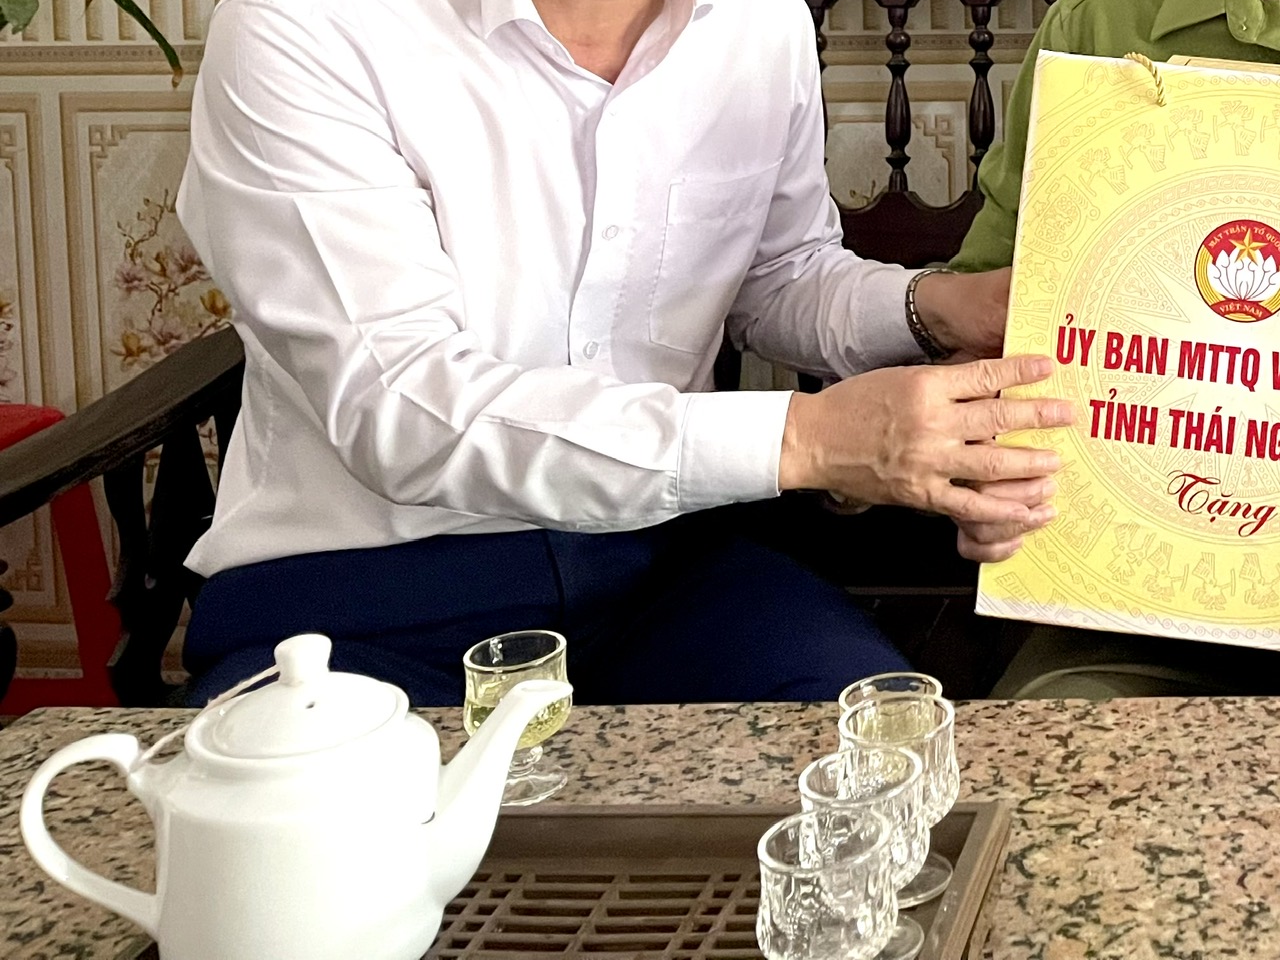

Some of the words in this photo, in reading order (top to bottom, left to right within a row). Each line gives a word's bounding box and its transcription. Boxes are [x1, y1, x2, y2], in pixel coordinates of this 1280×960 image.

[1242, 304, 1263, 317] NAM
[1057, 314, 1096, 367] ỦY
[1104, 332, 1169, 376] BAN
[1178, 341, 1261, 392] MTTQ
[1089, 387, 1159, 445] TỈNH
[1169, 406, 1237, 455] THÁI
[1167, 469, 1278, 537] Tặng
